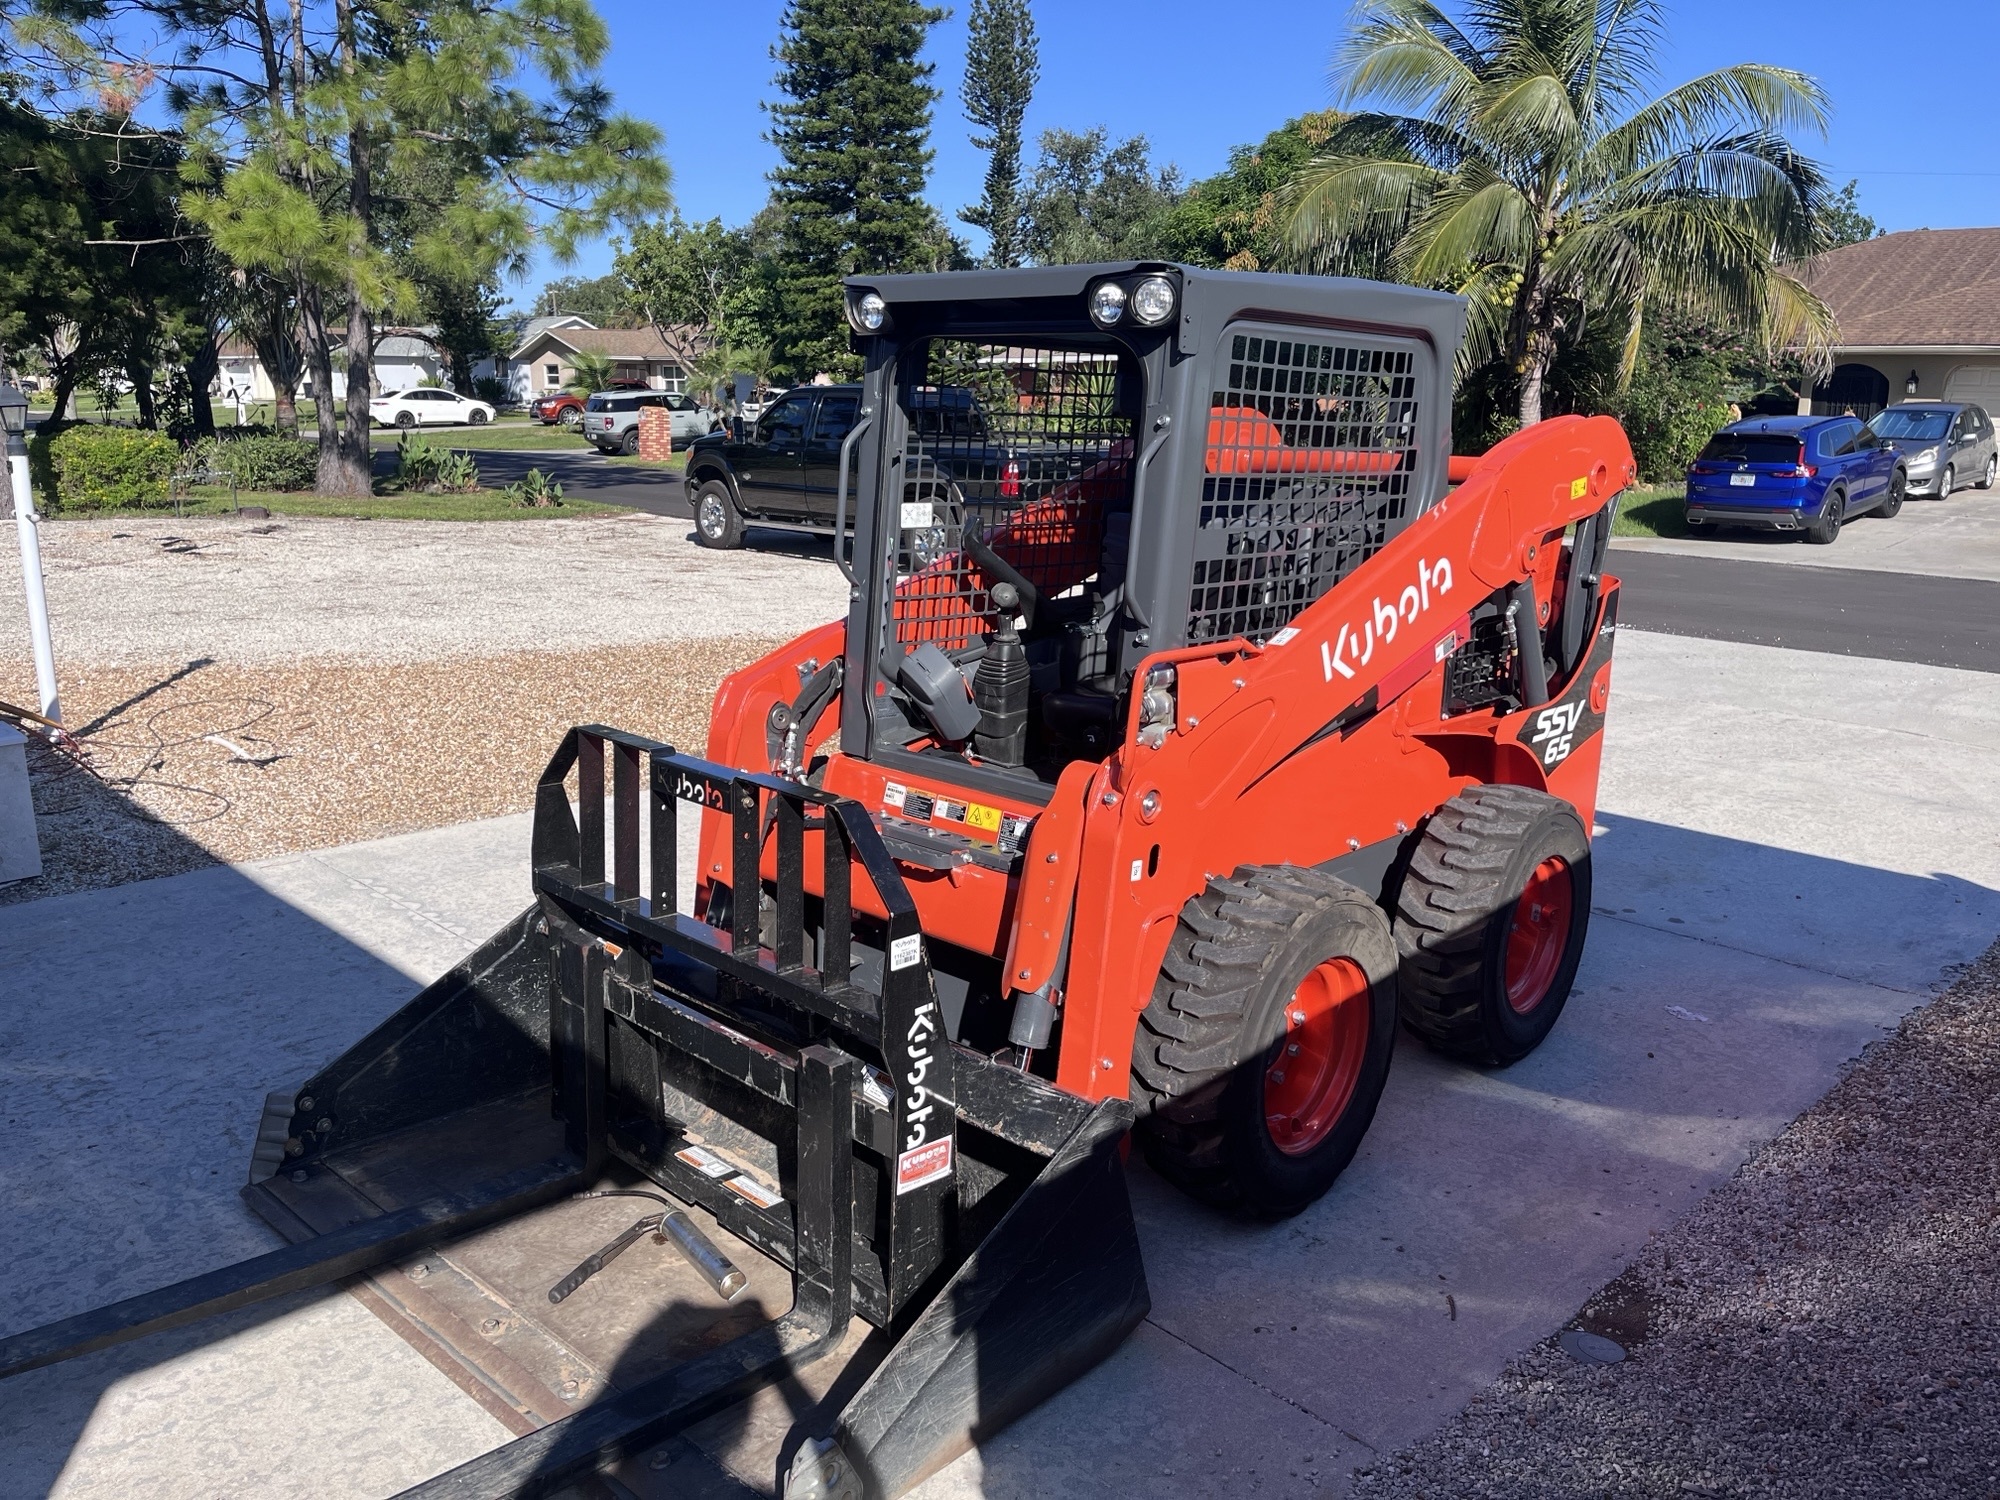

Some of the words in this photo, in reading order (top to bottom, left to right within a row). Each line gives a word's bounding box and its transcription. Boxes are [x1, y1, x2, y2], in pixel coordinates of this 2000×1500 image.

[1320, 557, 1453, 683] Kubota
[1531, 699, 1586, 743] SSV
[1544, 733, 1573, 765] 65
[907, 1002, 934, 1151] Kubota
